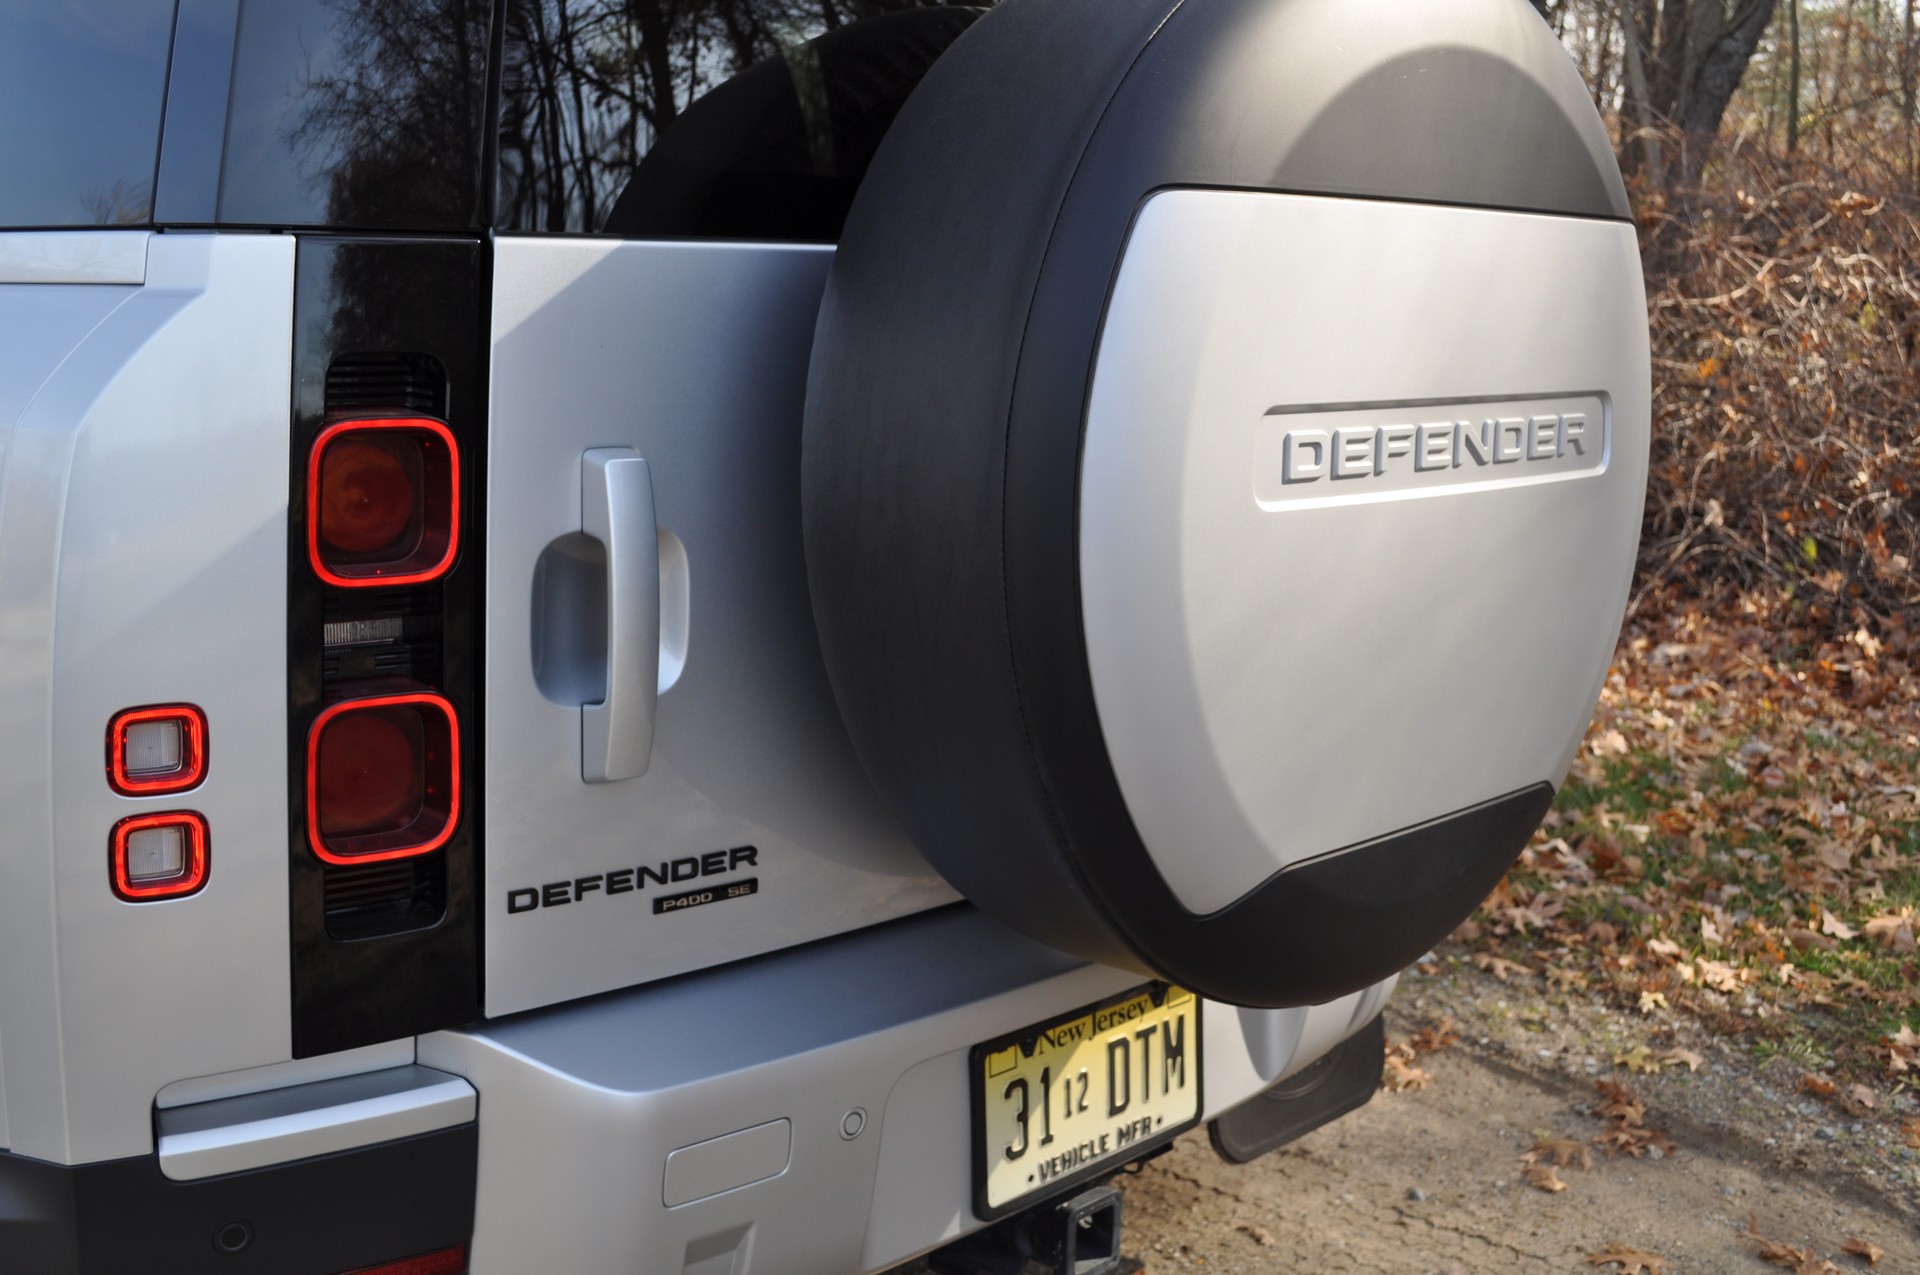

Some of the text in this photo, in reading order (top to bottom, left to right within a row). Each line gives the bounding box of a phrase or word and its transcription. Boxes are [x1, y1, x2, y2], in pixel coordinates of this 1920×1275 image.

[1281, 412, 1587, 485] DEFENDER
[507, 845, 758, 914] DEFENDER
[662, 884, 751, 911] P400 SE
[1039, 998, 1148, 1054] New Jersey
[1004, 1014, 1185, 1161] 31 12 DTM
[1038, 1117, 1152, 1181] VEHICLE MFR
